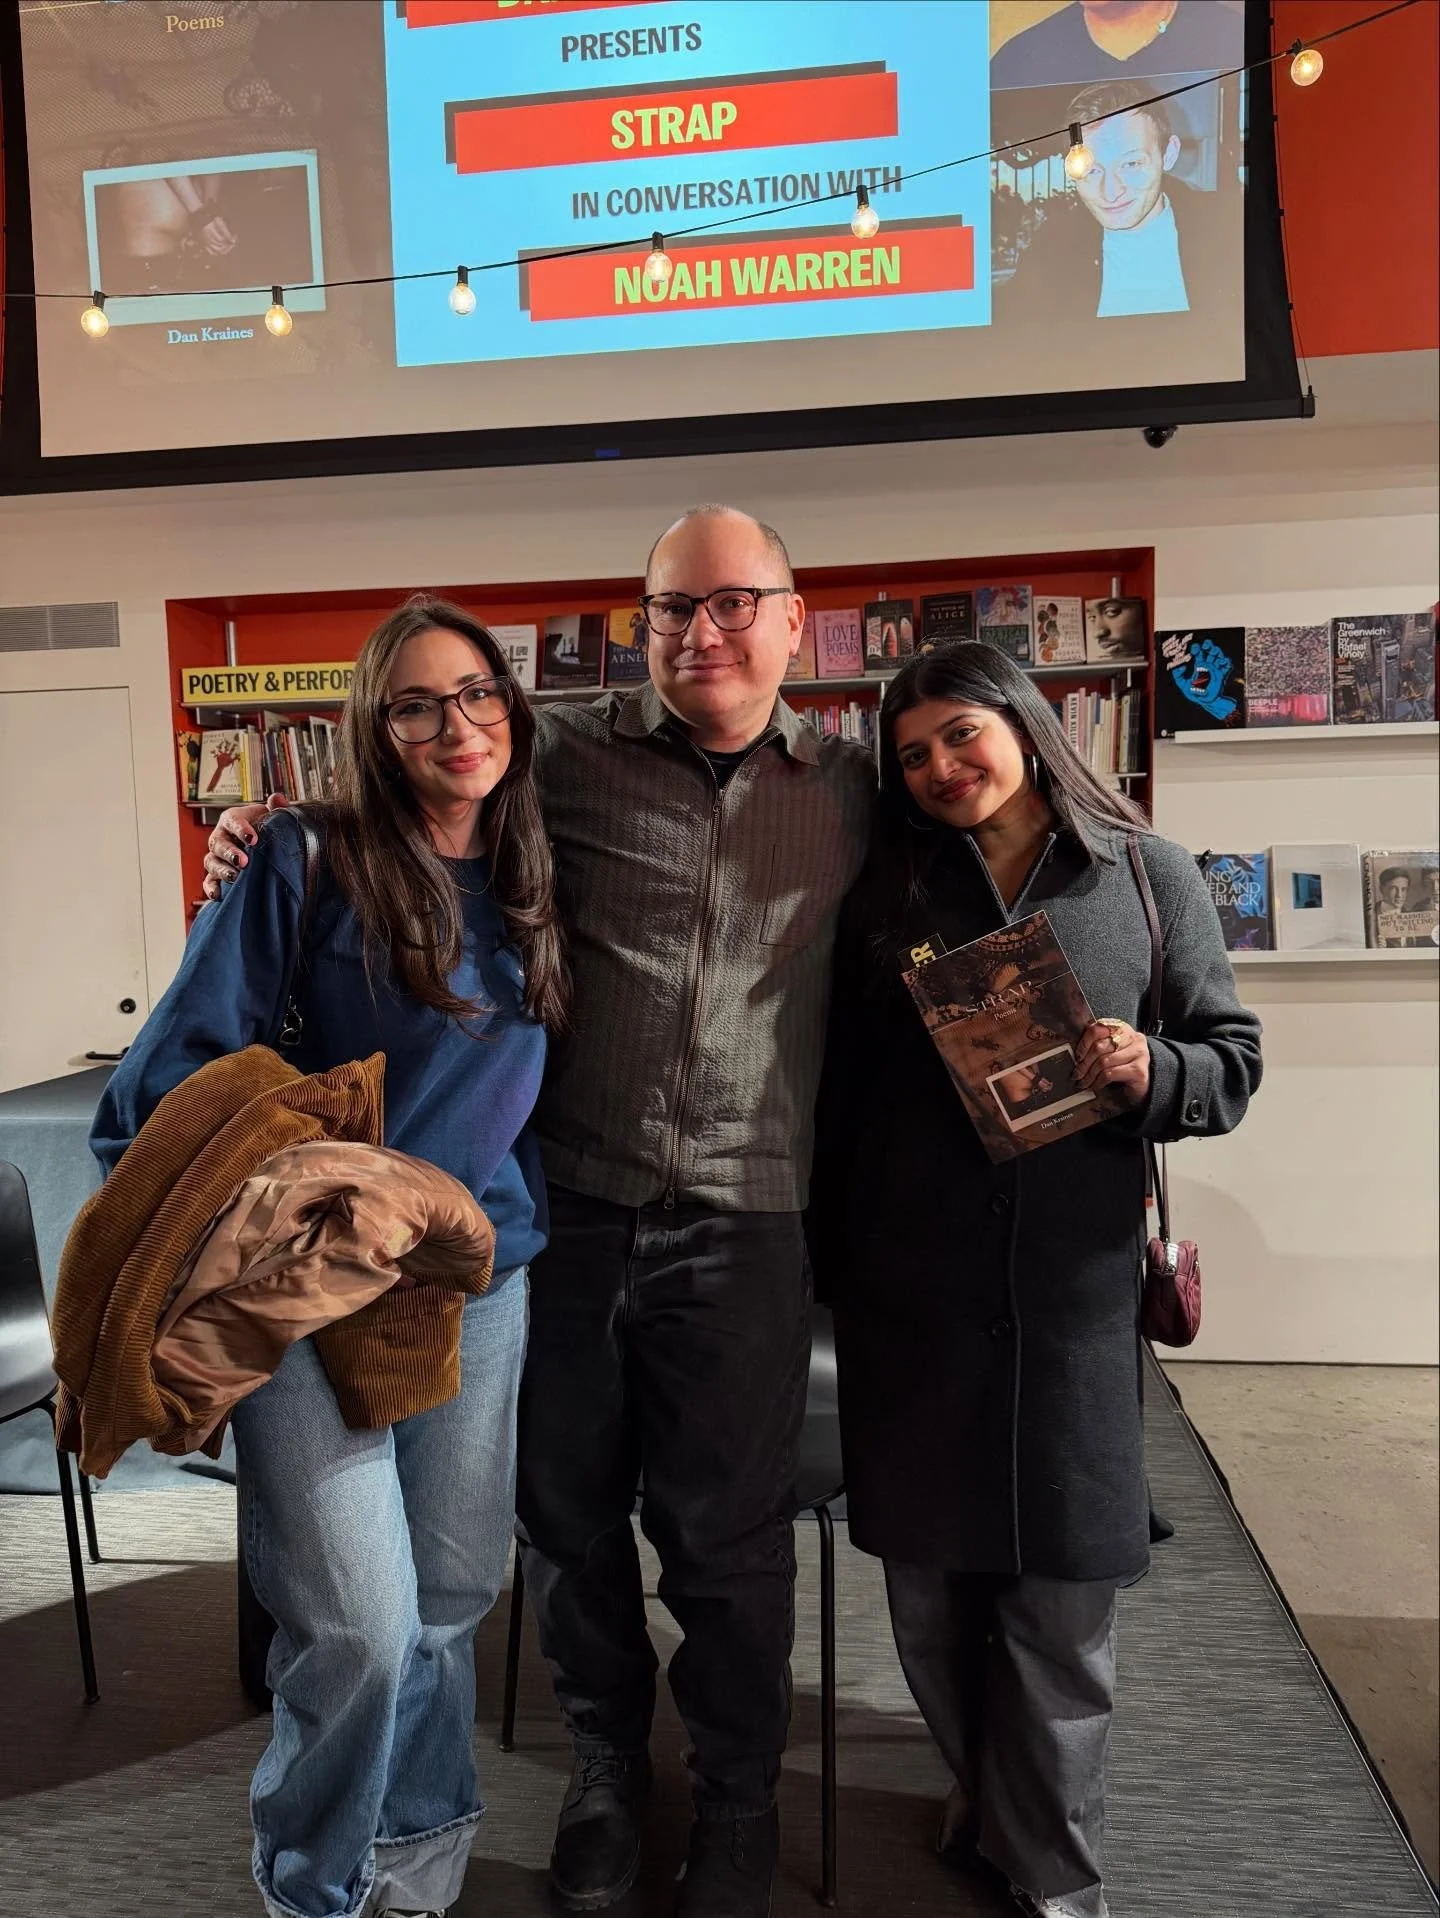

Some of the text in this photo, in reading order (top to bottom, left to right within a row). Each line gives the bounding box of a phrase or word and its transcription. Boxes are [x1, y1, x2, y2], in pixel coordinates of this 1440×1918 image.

[165, 15, 224, 33] Poems
[561, 22, 703, 63] PRESENTS
[611, 101, 738, 150] STRAP
[572, 166, 902, 219] IN CONVERSATION WITH
[614, 246, 901, 304] NOAH WARREN
[167, 326, 254, 344] Dan Kraines
[824, 624, 857, 642] LOVE
[1338, 622, 1355, 630] The
[1338, 627, 1386, 637] Greenwich
[826, 642, 860, 656] POEMS
[189, 672, 259, 695] POETRY
[264, 671, 280, 692] &
[1228, 882, 1261, 894] AND
[1215, 894, 1259, 906] BLACK
[966, 981, 1032, 1012] STRAP
[994, 1008, 1017, 1020] Poems
